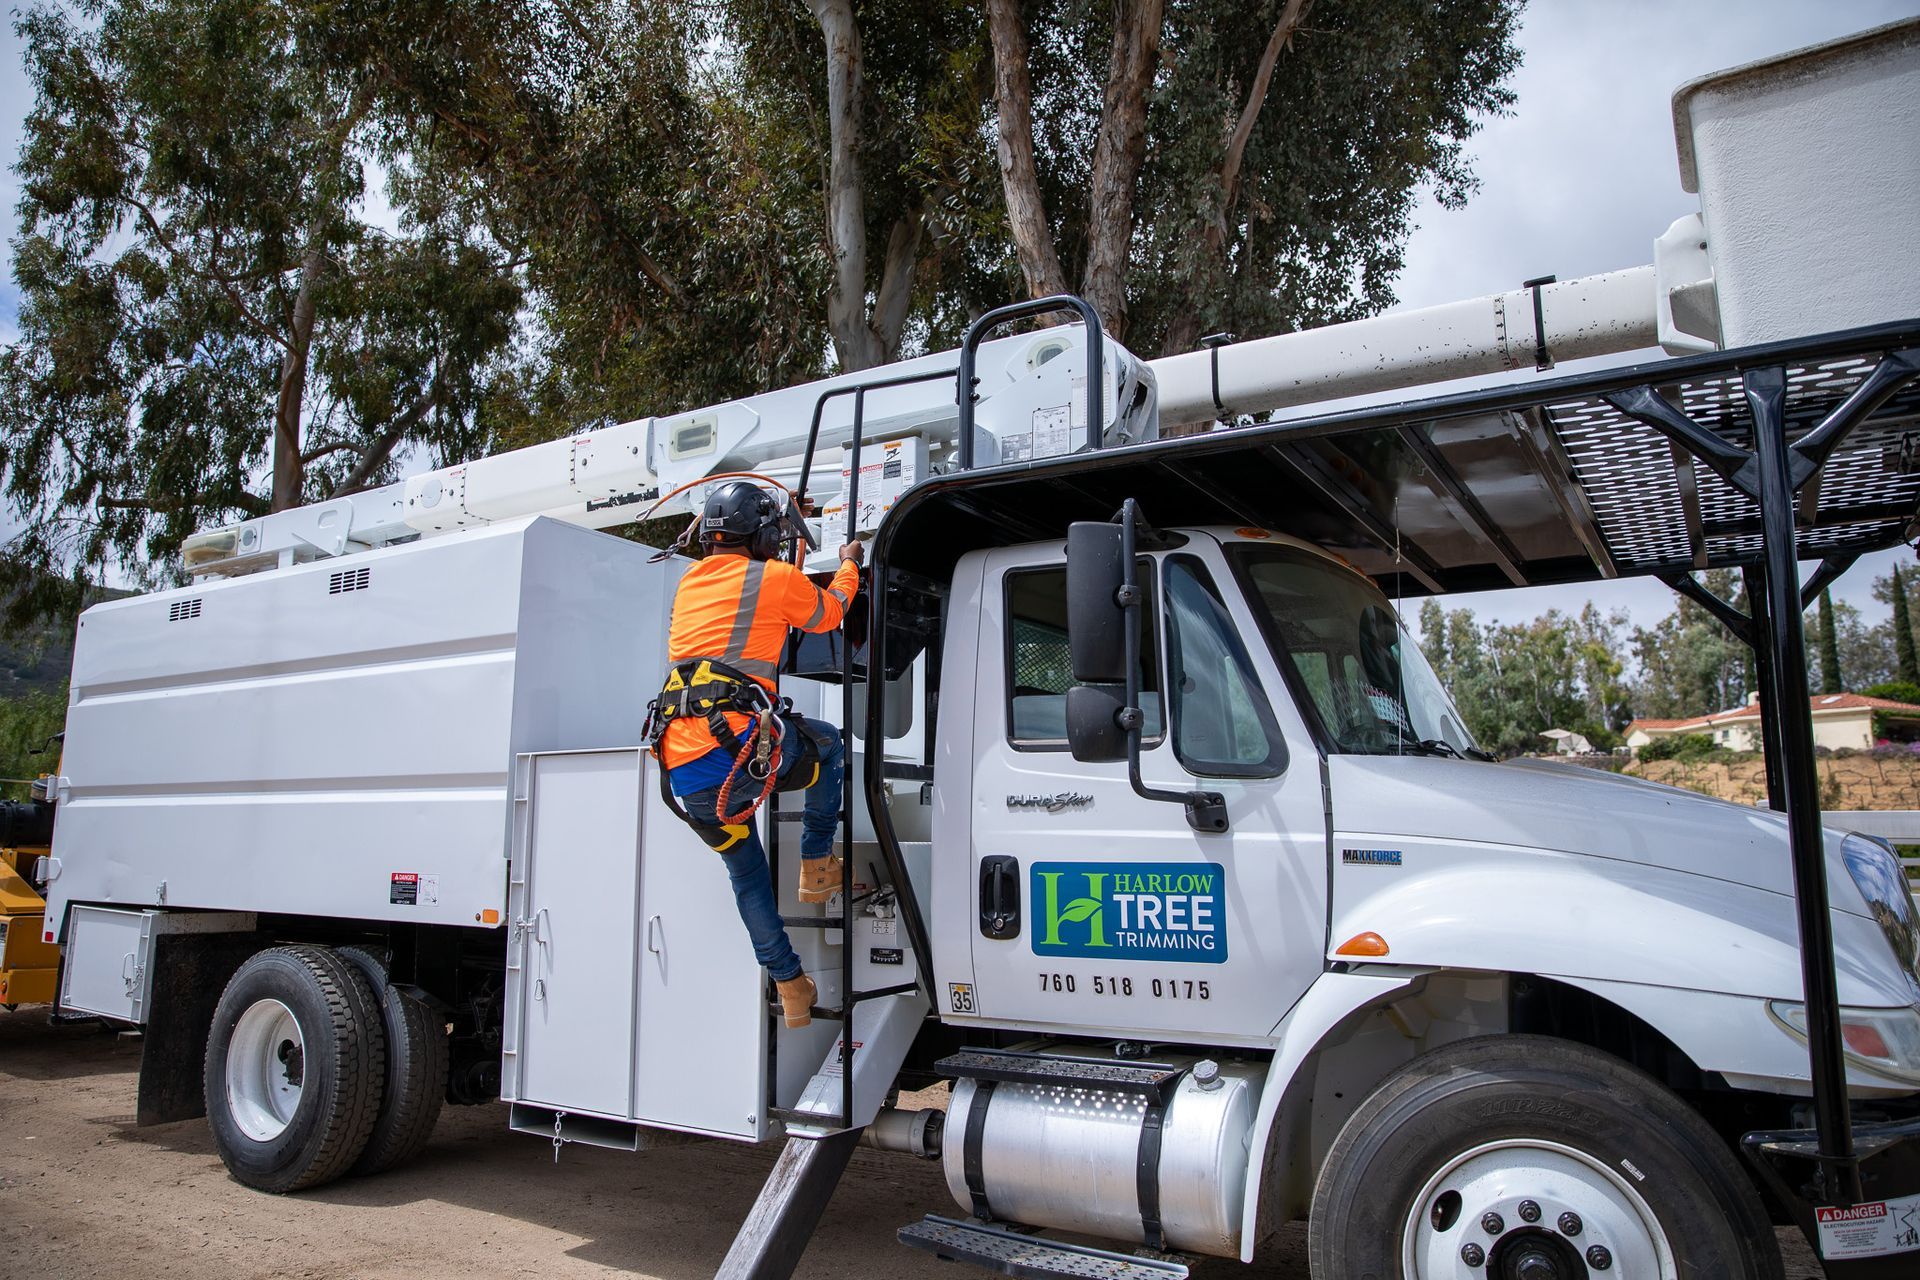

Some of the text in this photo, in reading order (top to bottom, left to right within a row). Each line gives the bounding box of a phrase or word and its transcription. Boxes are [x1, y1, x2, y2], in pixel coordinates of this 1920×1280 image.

[1343, 849, 1402, 863] MAXXFORCE
[1114, 873, 1214, 894] HARLOW
[1113, 894, 1214, 932] TREE
[1116, 931, 1215, 950] TRIMMING
[1039, 973, 1210, 1000] 760 518 0175
[953, 990, 972, 1011] 35
[1833, 1205, 1884, 1220] DANGER
